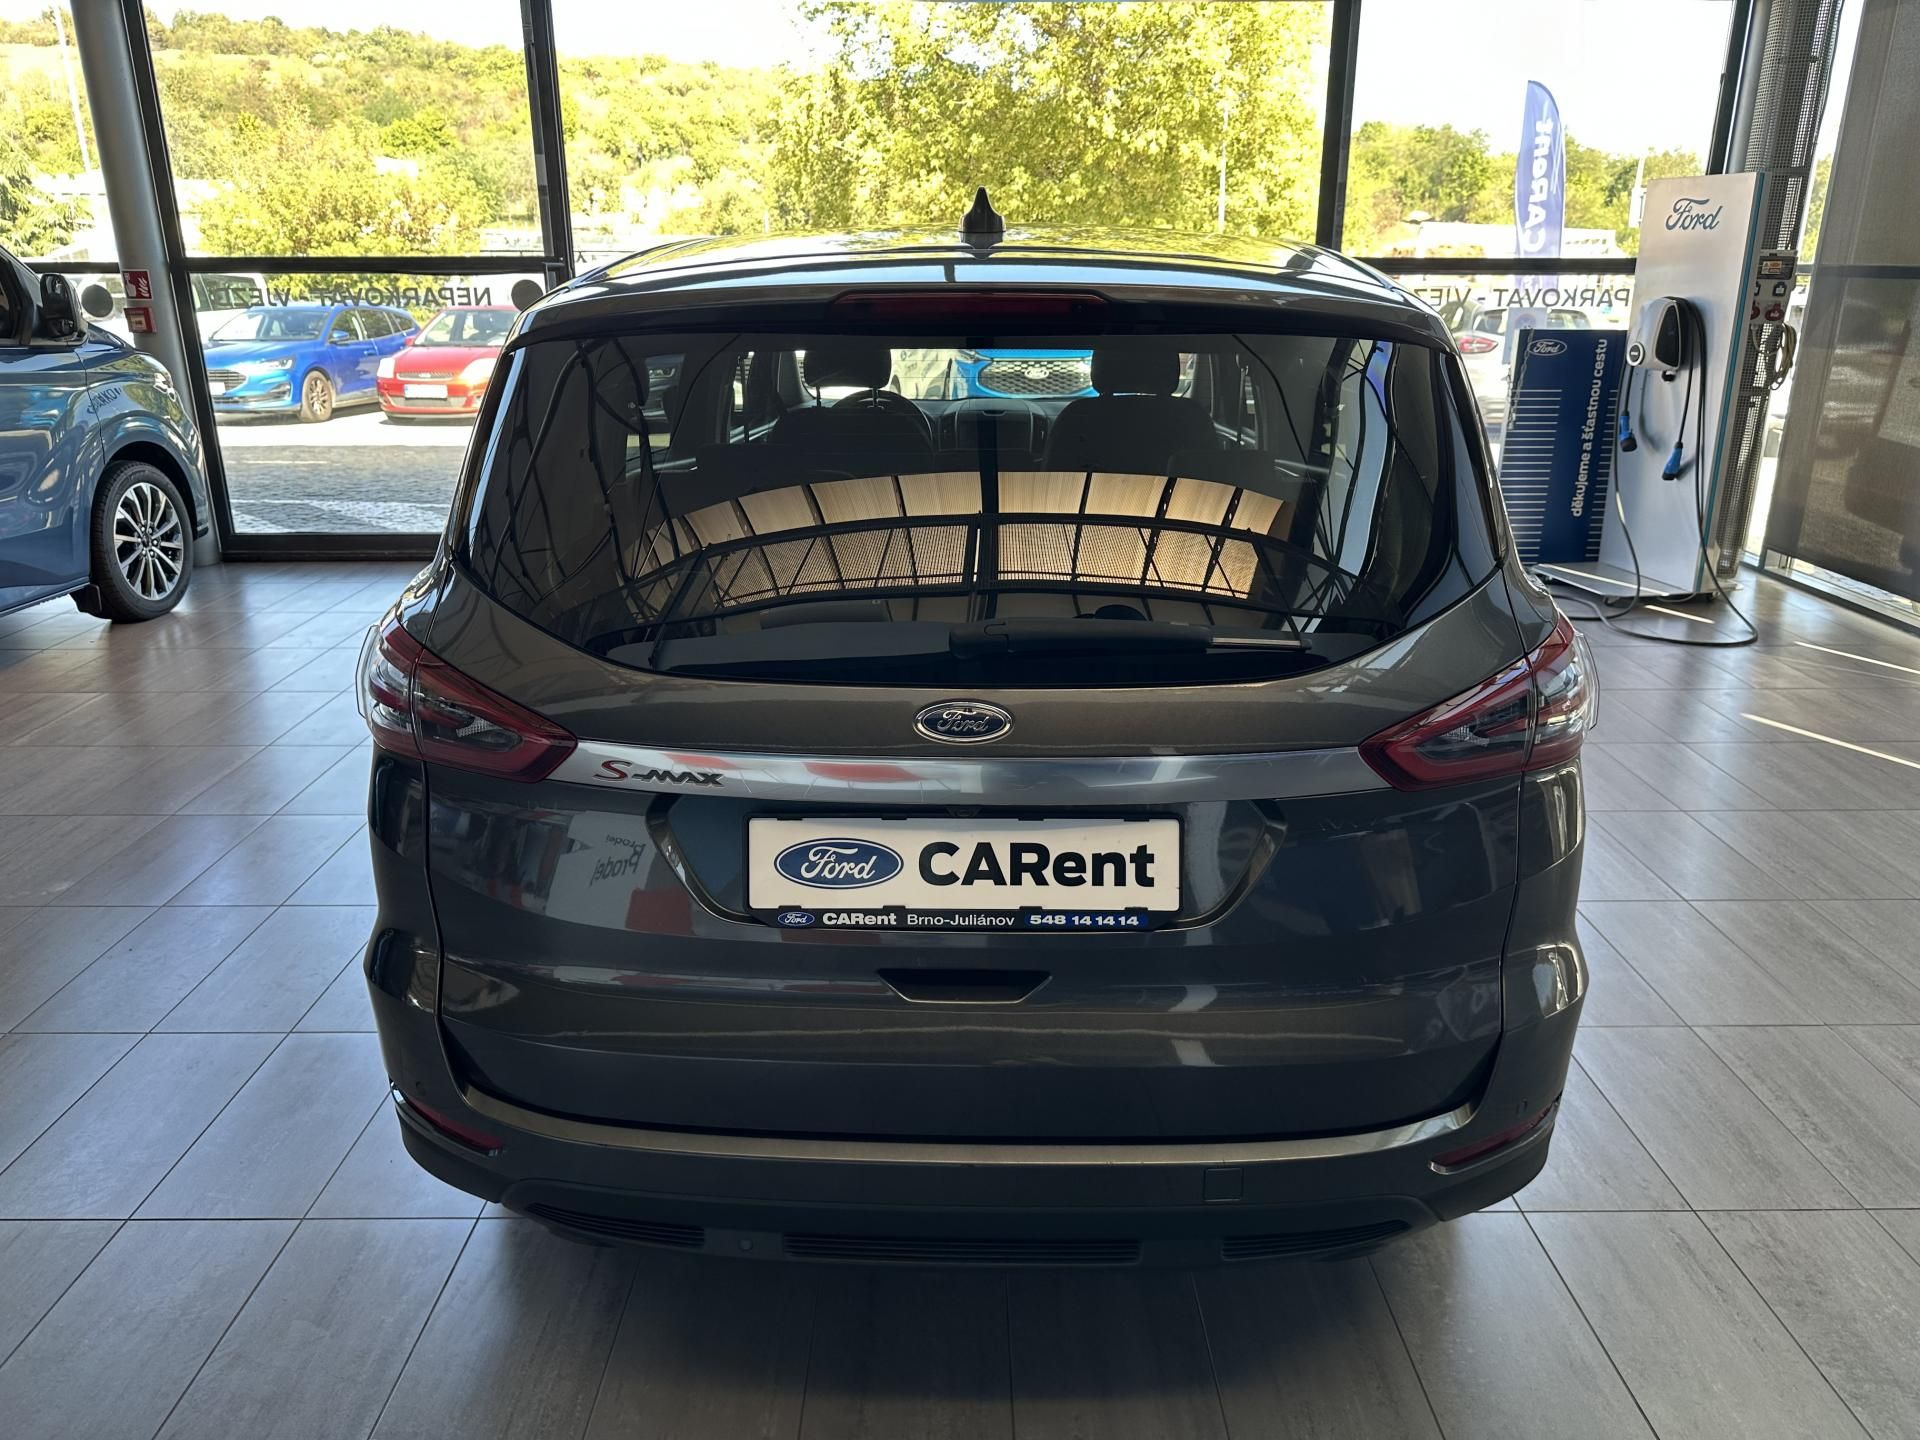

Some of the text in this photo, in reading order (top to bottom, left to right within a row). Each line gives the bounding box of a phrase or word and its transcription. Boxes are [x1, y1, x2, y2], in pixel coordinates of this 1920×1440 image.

[1665, 197, 1723, 231] Ford
[1533, 340, 1561, 354] Ford
[1570, 338, 1608, 517] děkujeme a šťastnou cestu
[593, 759, 724, 787] S-MAX
[800, 841, 1155, 887] Ford CARent
[822, 912, 897, 925] CARent
[907, 914, 1015, 926] Brno-Juliánov
[1029, 915, 1066, 926] 548
[1071, 916, 1092, 926] 14
[1095, 916, 1116, 926] 14
[1118, 916, 1139, 926] 14
